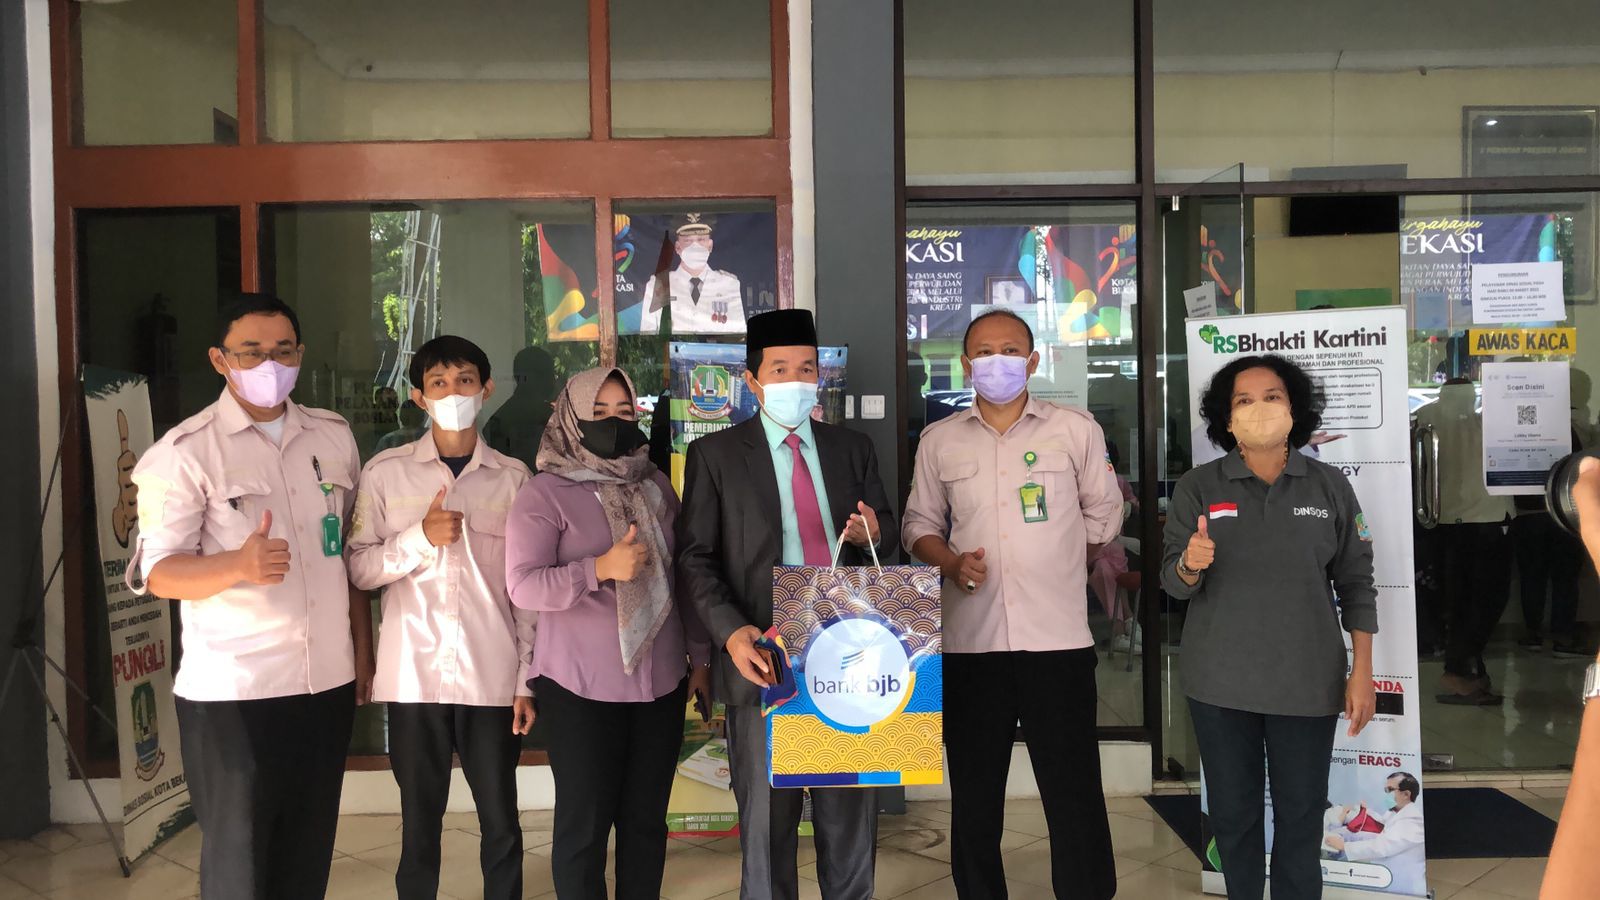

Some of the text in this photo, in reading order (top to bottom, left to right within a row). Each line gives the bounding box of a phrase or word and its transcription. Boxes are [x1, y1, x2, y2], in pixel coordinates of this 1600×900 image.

[915, 272, 935, 280] DAYA
[937, 272, 962, 280] SAING
[1313, 326, 1387, 348] Kartini
[1477, 333, 1569, 351] AWAS KACA
[1293, 506, 1329, 519] DINSOS
[814, 674, 901, 697] bank bjb
[1358, 754, 1401, 768] ERACS
[154, 781, 171, 796] KOTA
